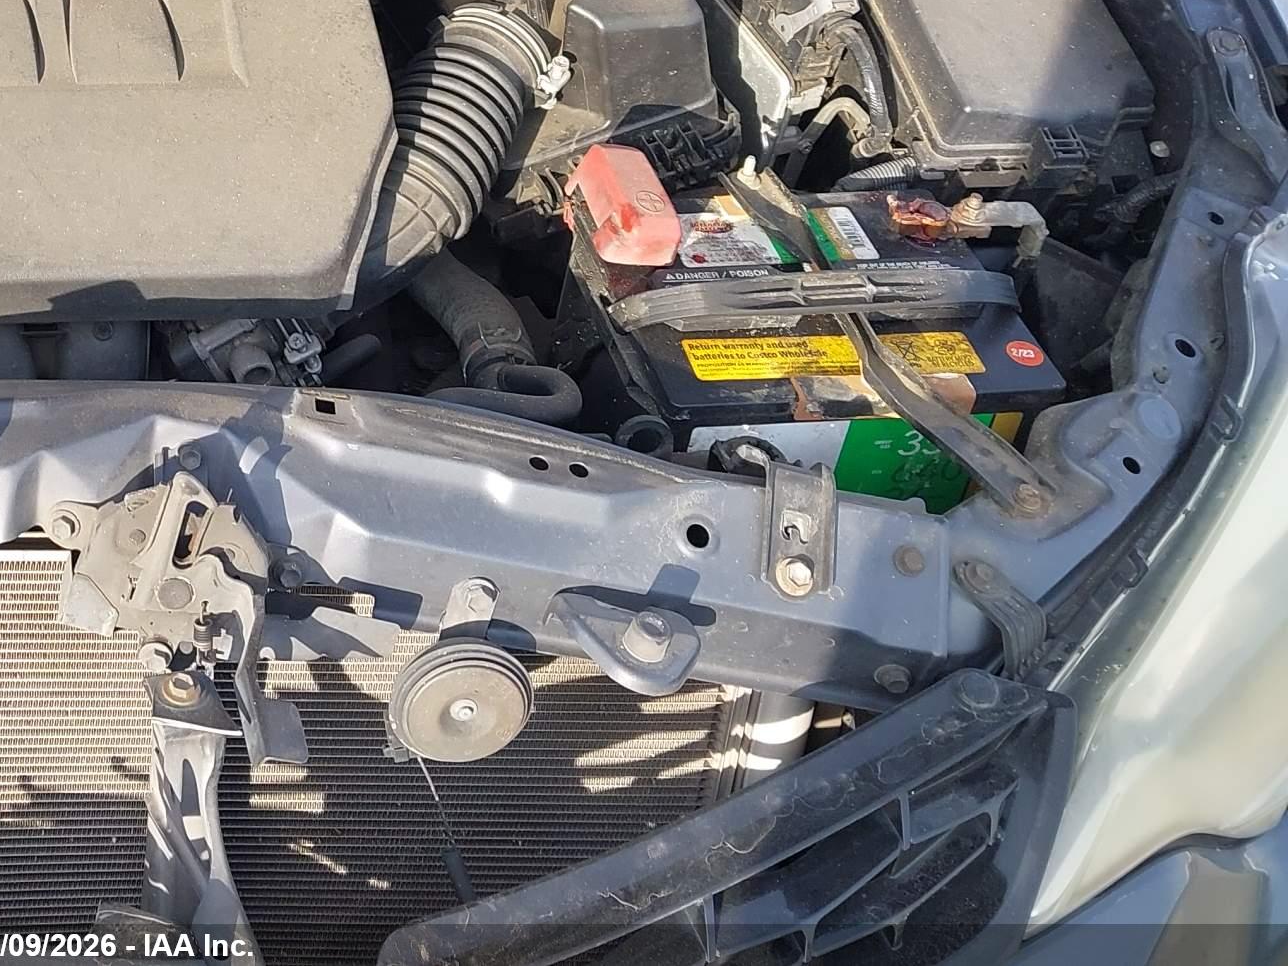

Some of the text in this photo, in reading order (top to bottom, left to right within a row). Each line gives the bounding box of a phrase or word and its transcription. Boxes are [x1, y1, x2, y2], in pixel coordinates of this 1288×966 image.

[676, 271, 720, 280] DANGER
[729, 269, 769, 278] POISON
[688, 340, 809, 352] Return warranty and used
[692, 351, 735, 361] batteries
[736, 351, 746, 360] to
[747, 351, 778, 360] Costco
